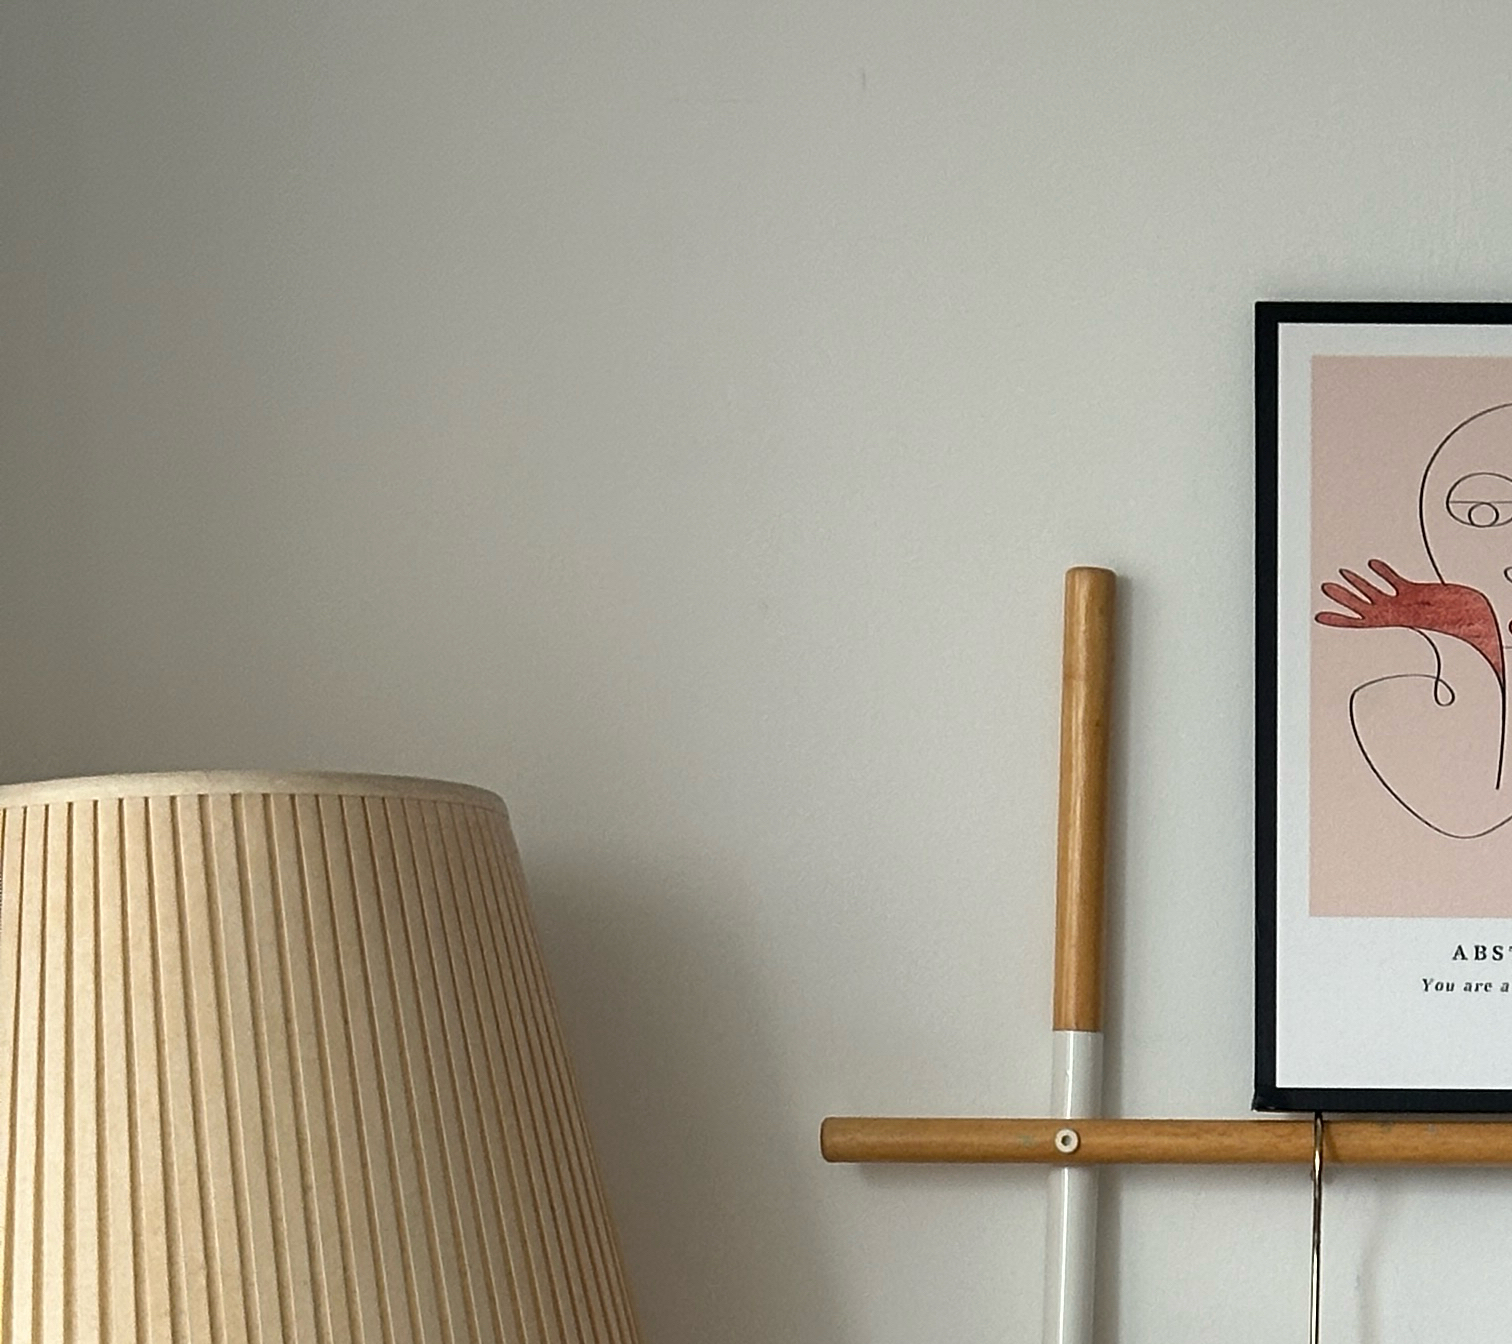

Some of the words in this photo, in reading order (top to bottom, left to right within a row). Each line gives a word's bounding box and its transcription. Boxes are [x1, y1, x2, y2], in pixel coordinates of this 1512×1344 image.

[1422, 977, 1455, 993] You
[1463, 981, 1494, 993] are
[1500, 981, 1511, 993] a
